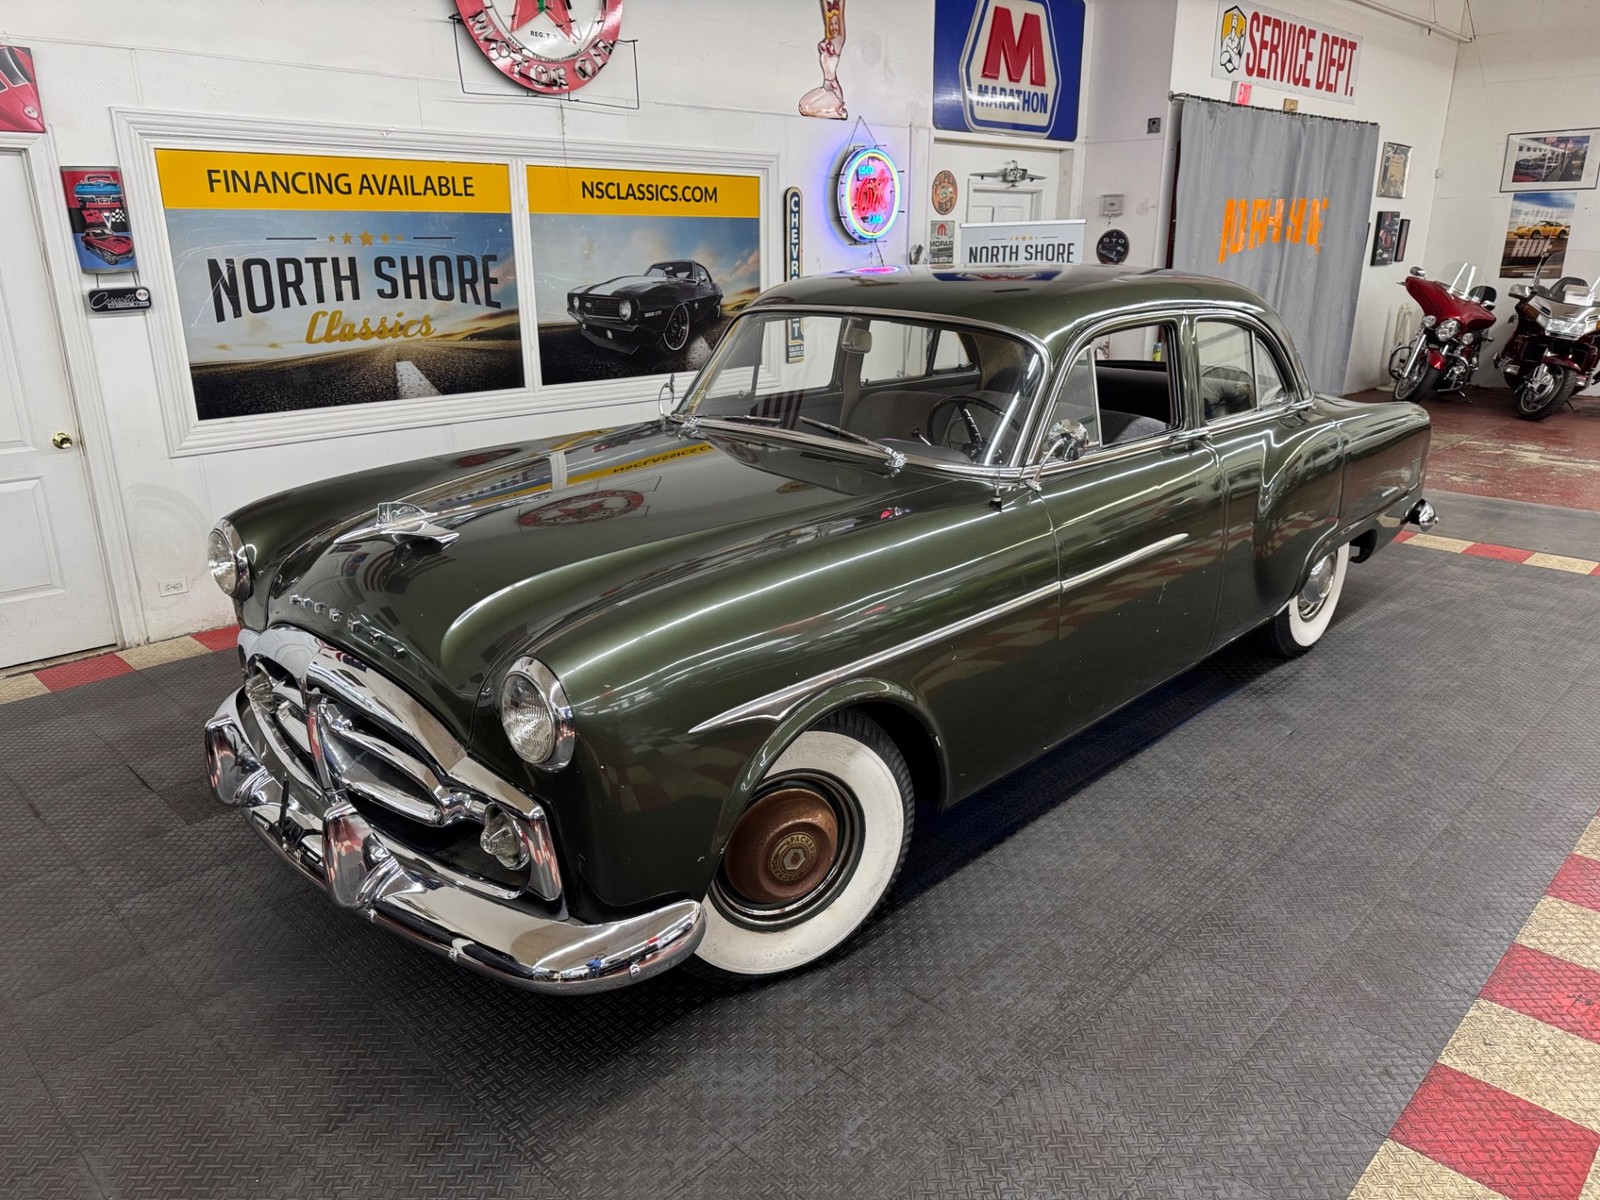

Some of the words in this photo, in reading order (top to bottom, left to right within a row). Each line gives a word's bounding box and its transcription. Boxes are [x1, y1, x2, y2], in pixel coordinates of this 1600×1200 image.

[468, 9, 569, 90] MOTOR
[981, 5, 1046, 87] M
[1245, 10, 1317, 88] SERVICE
[1315, 32, 1358, 97] DEPT.
[976, 83, 1049, 114] MARATHON
[206, 168, 352, 195] FINANCING
[358, 173, 476, 197] AVAILABLE
[581, 180, 718, 203] NSCLASSICS.COM
[937, 196, 955, 212] BEE
[929, 240, 953, 248] MOPAR
[968, 244, 1019, 264] NORTH
[1024, 242, 1075, 264] SHORE
[1511, 238, 1553, 258] RIDE
[91, 291, 137, 309] Corvette
[207, 256, 361, 323] NORTH
[373, 254, 502, 309] SHORE
[305, 309, 437, 345] Classics
